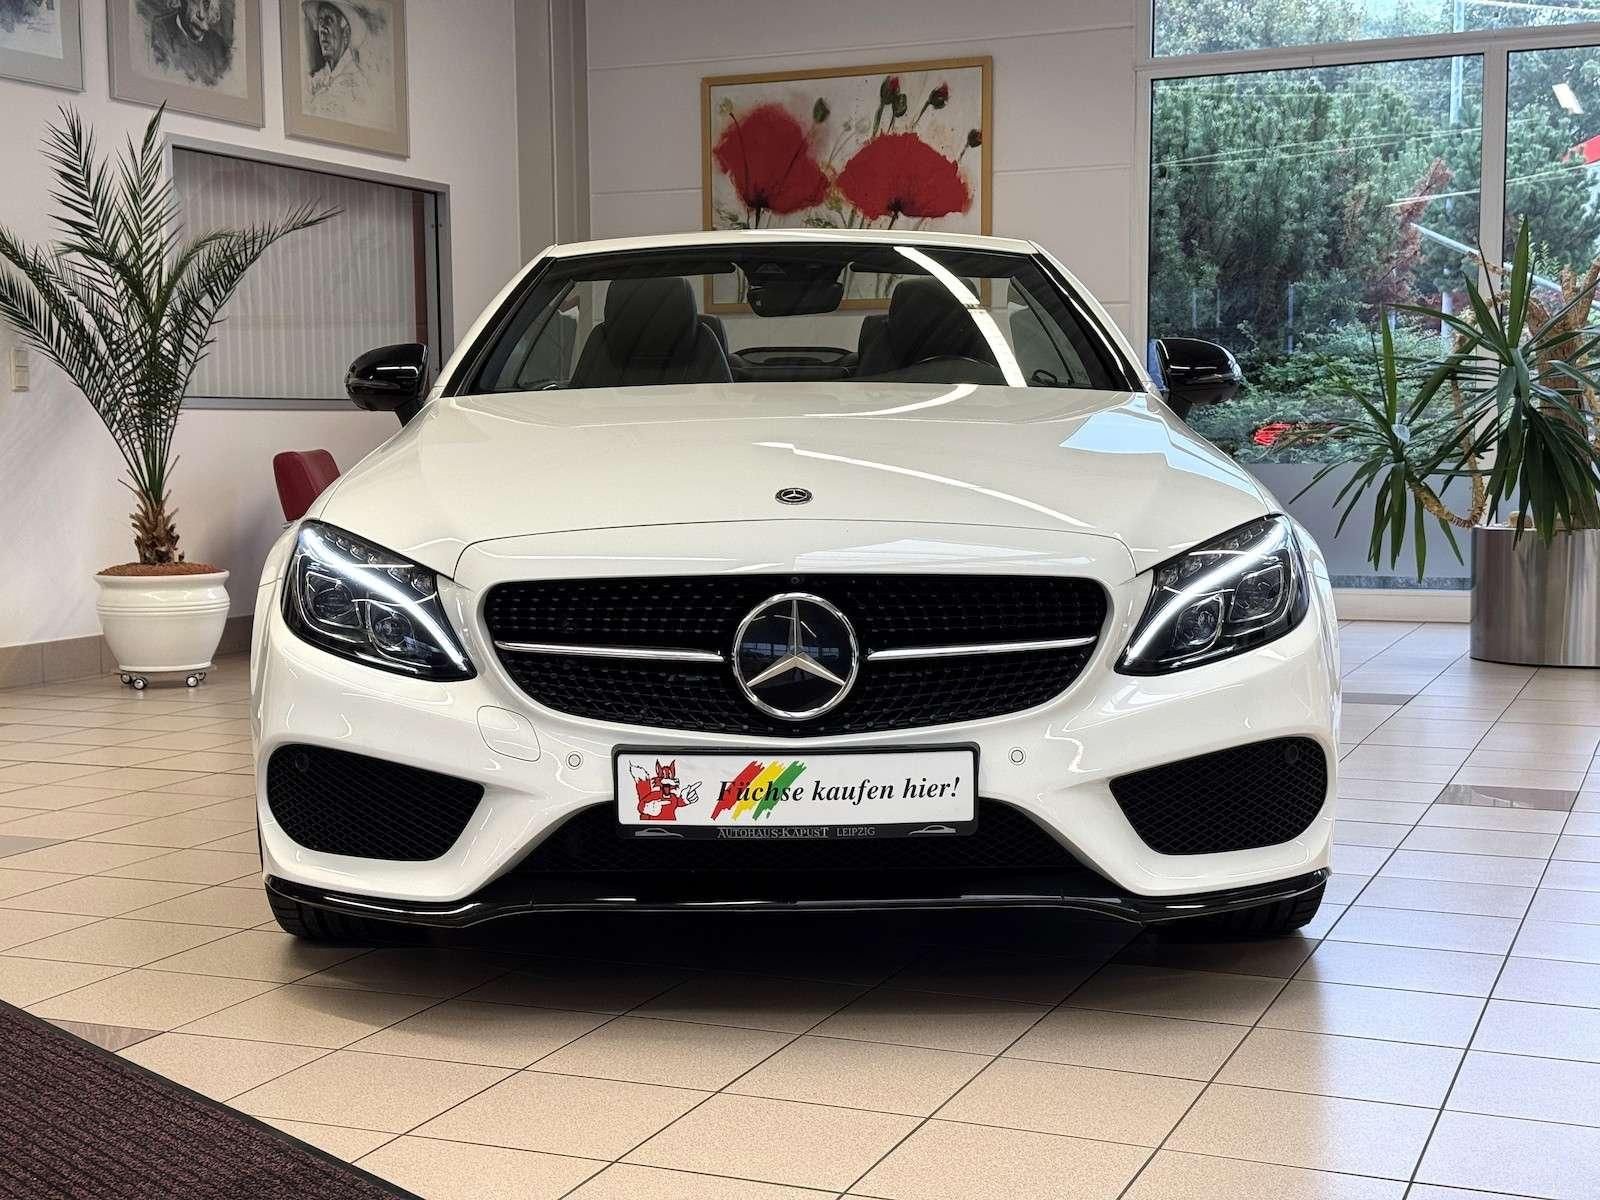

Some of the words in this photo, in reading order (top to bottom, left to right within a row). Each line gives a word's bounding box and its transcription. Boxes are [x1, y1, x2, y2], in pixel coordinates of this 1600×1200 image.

[717, 780, 804, 802] Füchse
[812, 779, 894, 806] kaufen
[902, 776, 960, 799] hier!
[836, 827, 876, 838] LEIPZIG
